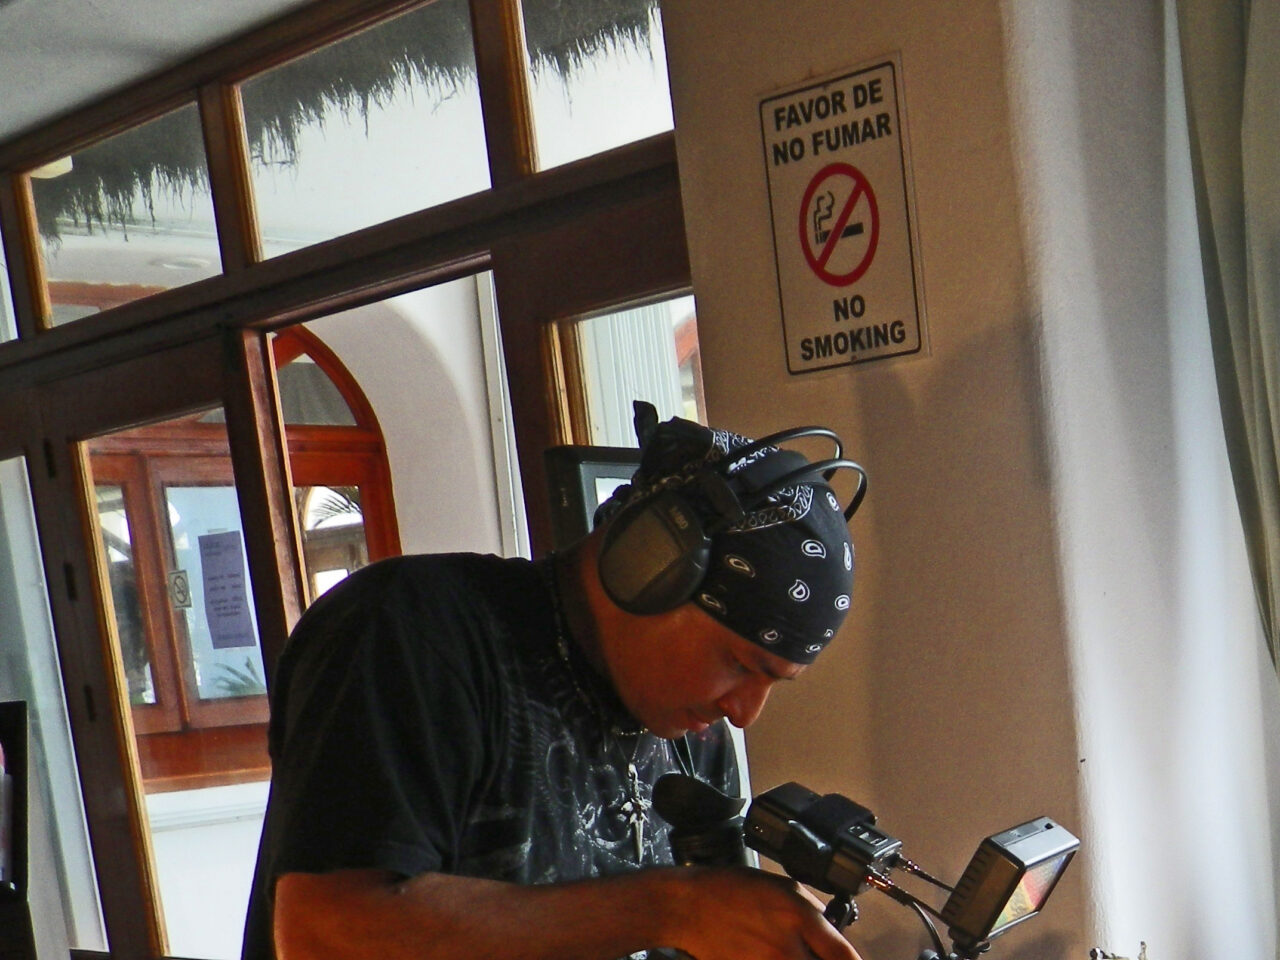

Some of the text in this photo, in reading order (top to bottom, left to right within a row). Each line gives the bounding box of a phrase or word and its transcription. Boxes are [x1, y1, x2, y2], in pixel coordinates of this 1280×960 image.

[774, 78, 883, 131] FAVOR DE
[772, 112, 892, 166] NO FUMAR
[833, 294, 866, 322] NO
[800, 320, 906, 361] SMOKING
